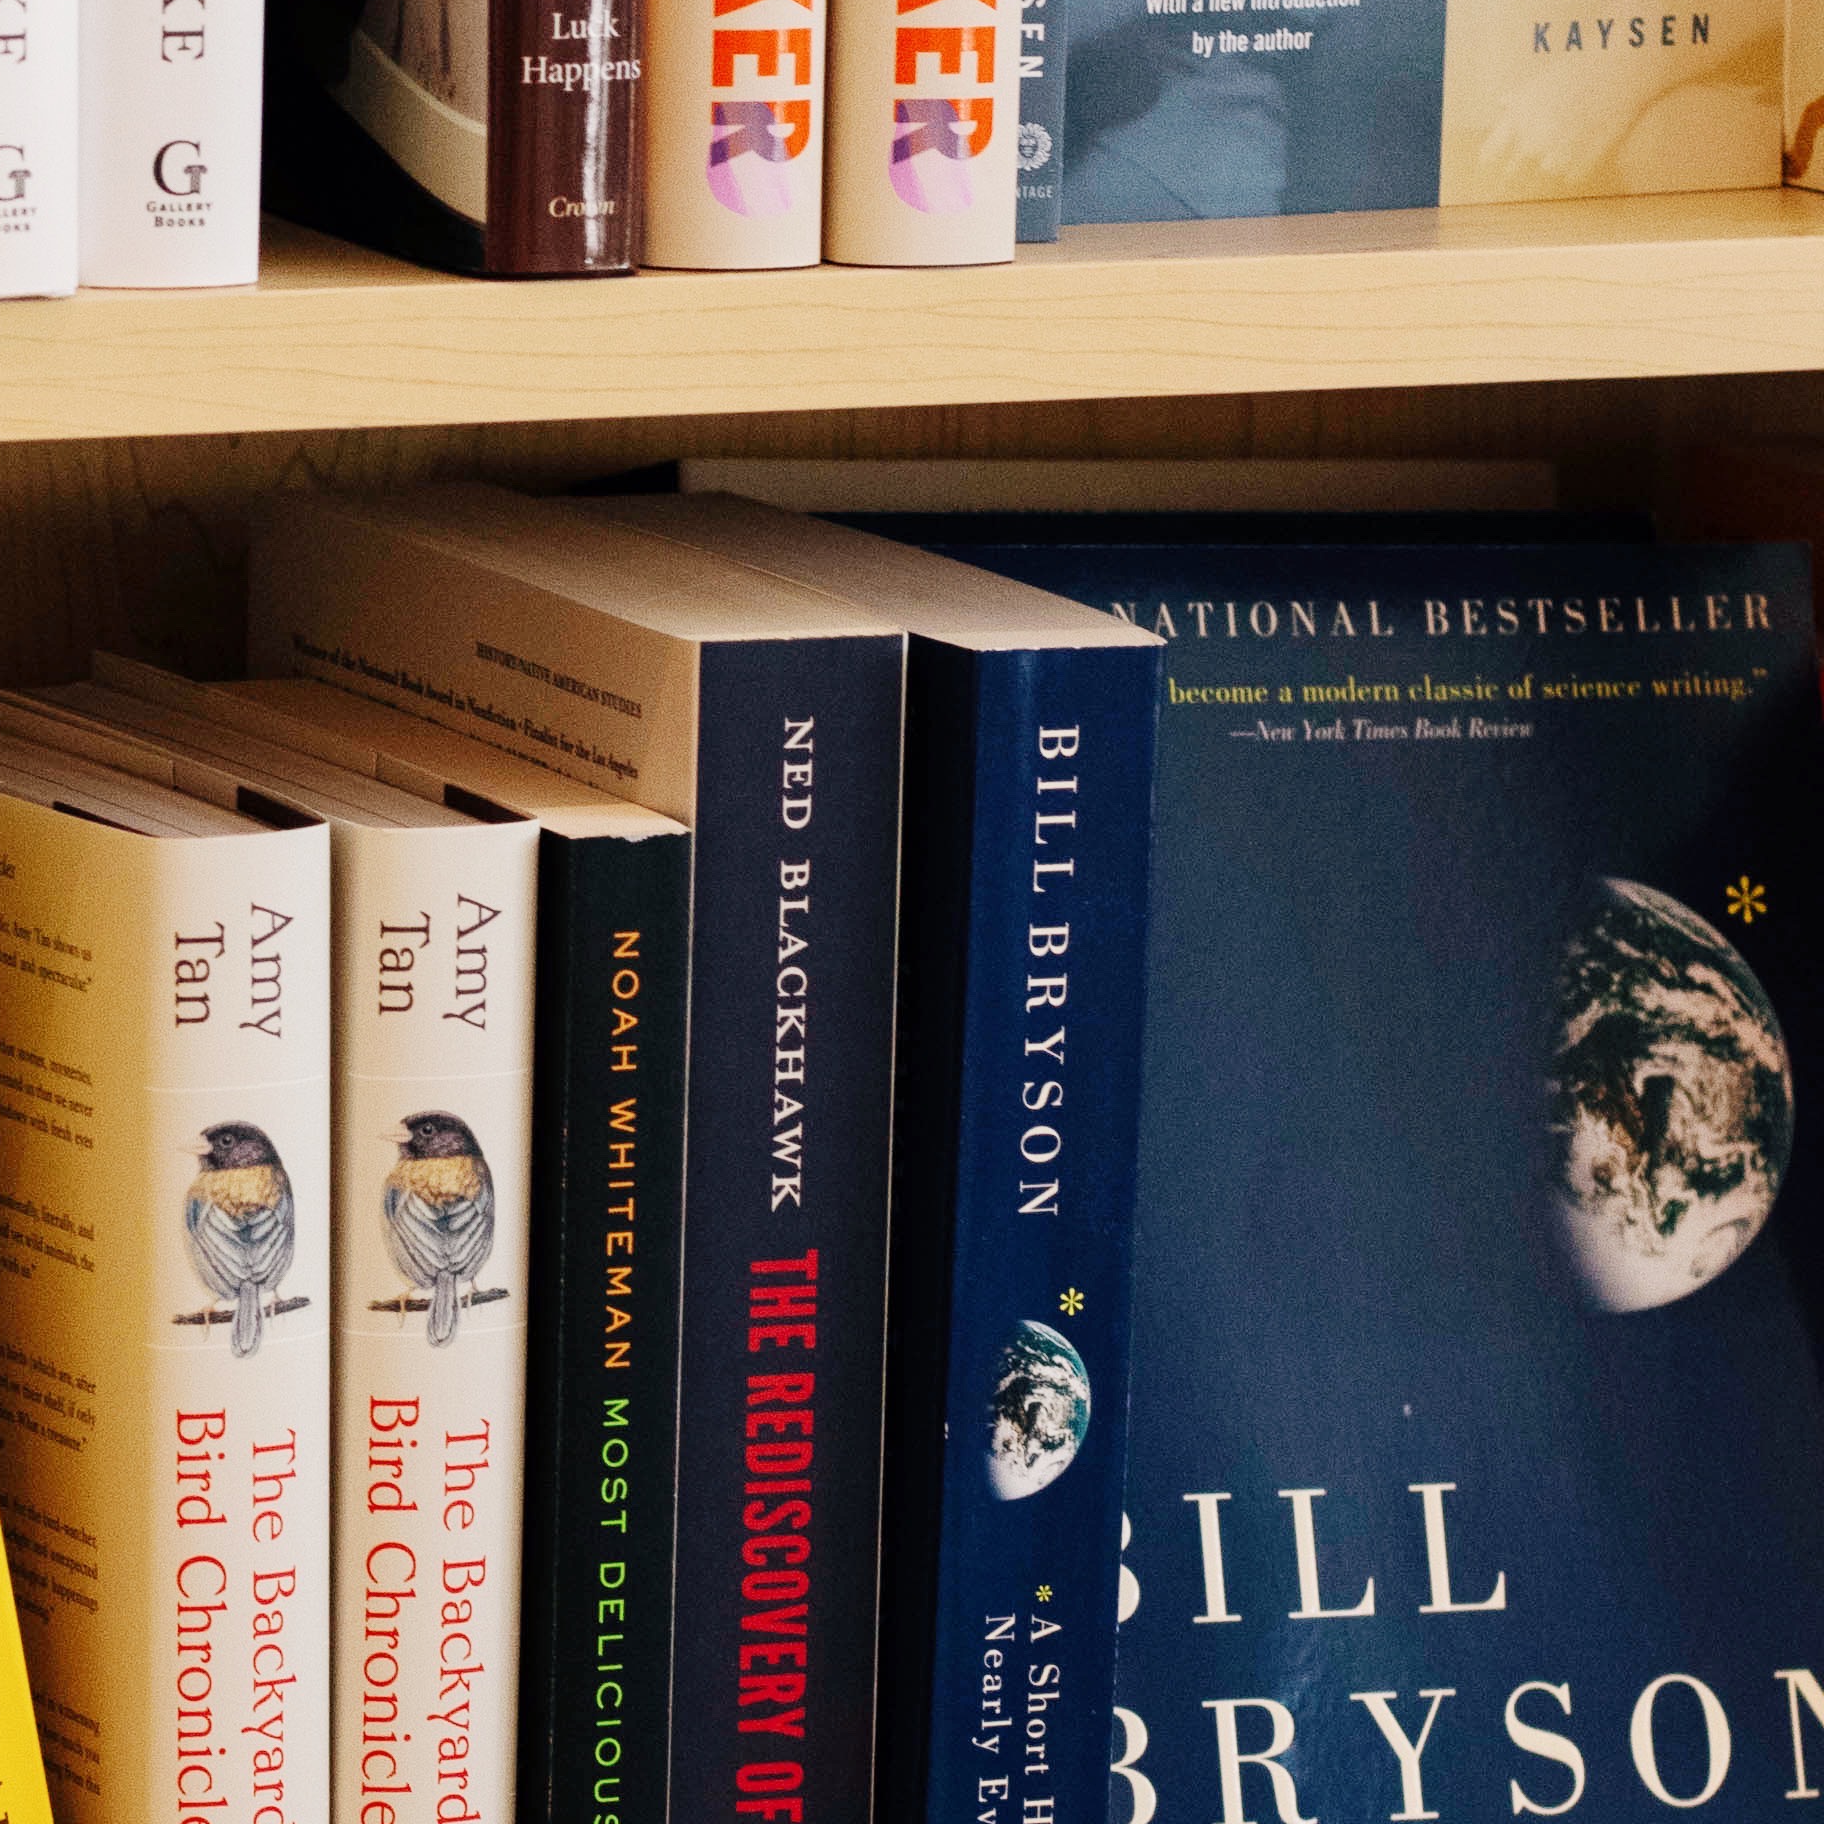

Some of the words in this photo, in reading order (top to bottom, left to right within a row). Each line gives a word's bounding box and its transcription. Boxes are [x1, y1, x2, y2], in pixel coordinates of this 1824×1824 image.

[1192, 28, 1214, 57] by
[1220, 28, 1247, 52] the
[1253, 28, 1312, 52] author
[1534, 15, 1712, 53] KAYSEN
[154, 216, 206, 228] BOOKS
[782, 717, 816, 832] NED
[1031, 724, 1080, 894] BILL
[176, 921, 224, 1027] Tan
[238, 902, 295, 1038] Amy
[610, 931, 640, 1074] NOAH
[771, 860, 813, 1214] BLACKHAWK
[1017, 923, 1071, 1218] BRYSON
[606, 1097, 638, 1371] WHITEMAN
[750, 1250, 820, 1351] THE
[176, 1409, 227, 1528] Bird
[252, 1428, 297, 1544] The
[601, 1398, 631, 1536] MOST
[737, 1374, 816, 1741] REDISCOVERY
[736, 1761, 804, 1824] OF
